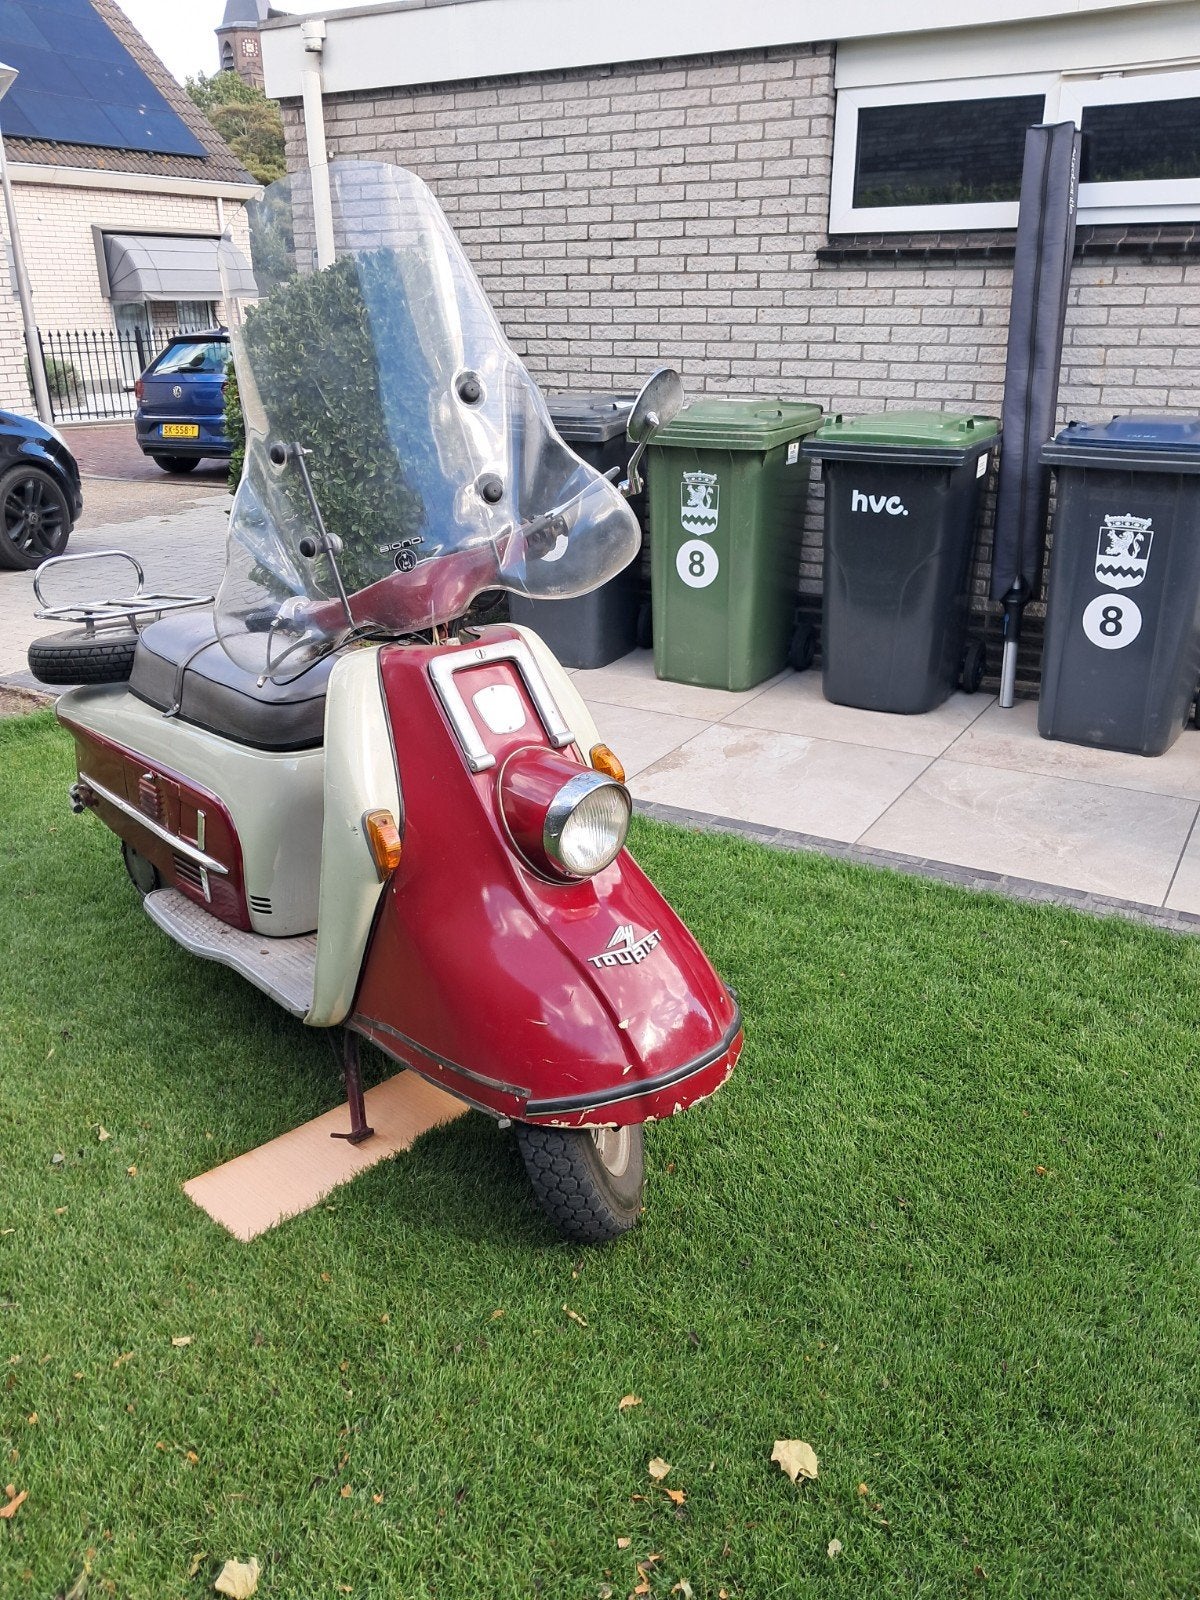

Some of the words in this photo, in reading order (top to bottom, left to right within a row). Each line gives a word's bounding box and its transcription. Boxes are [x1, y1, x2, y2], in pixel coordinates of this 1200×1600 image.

[164, 425, 195, 435] SK-558-T
[851, 489, 909, 516] hvc.
[380, 536, 424, 553] BIONDI
[688, 550, 705, 577] 8
[1099, 605, 1123, 637] 8
[587, 928, 662, 969] TOURIST
